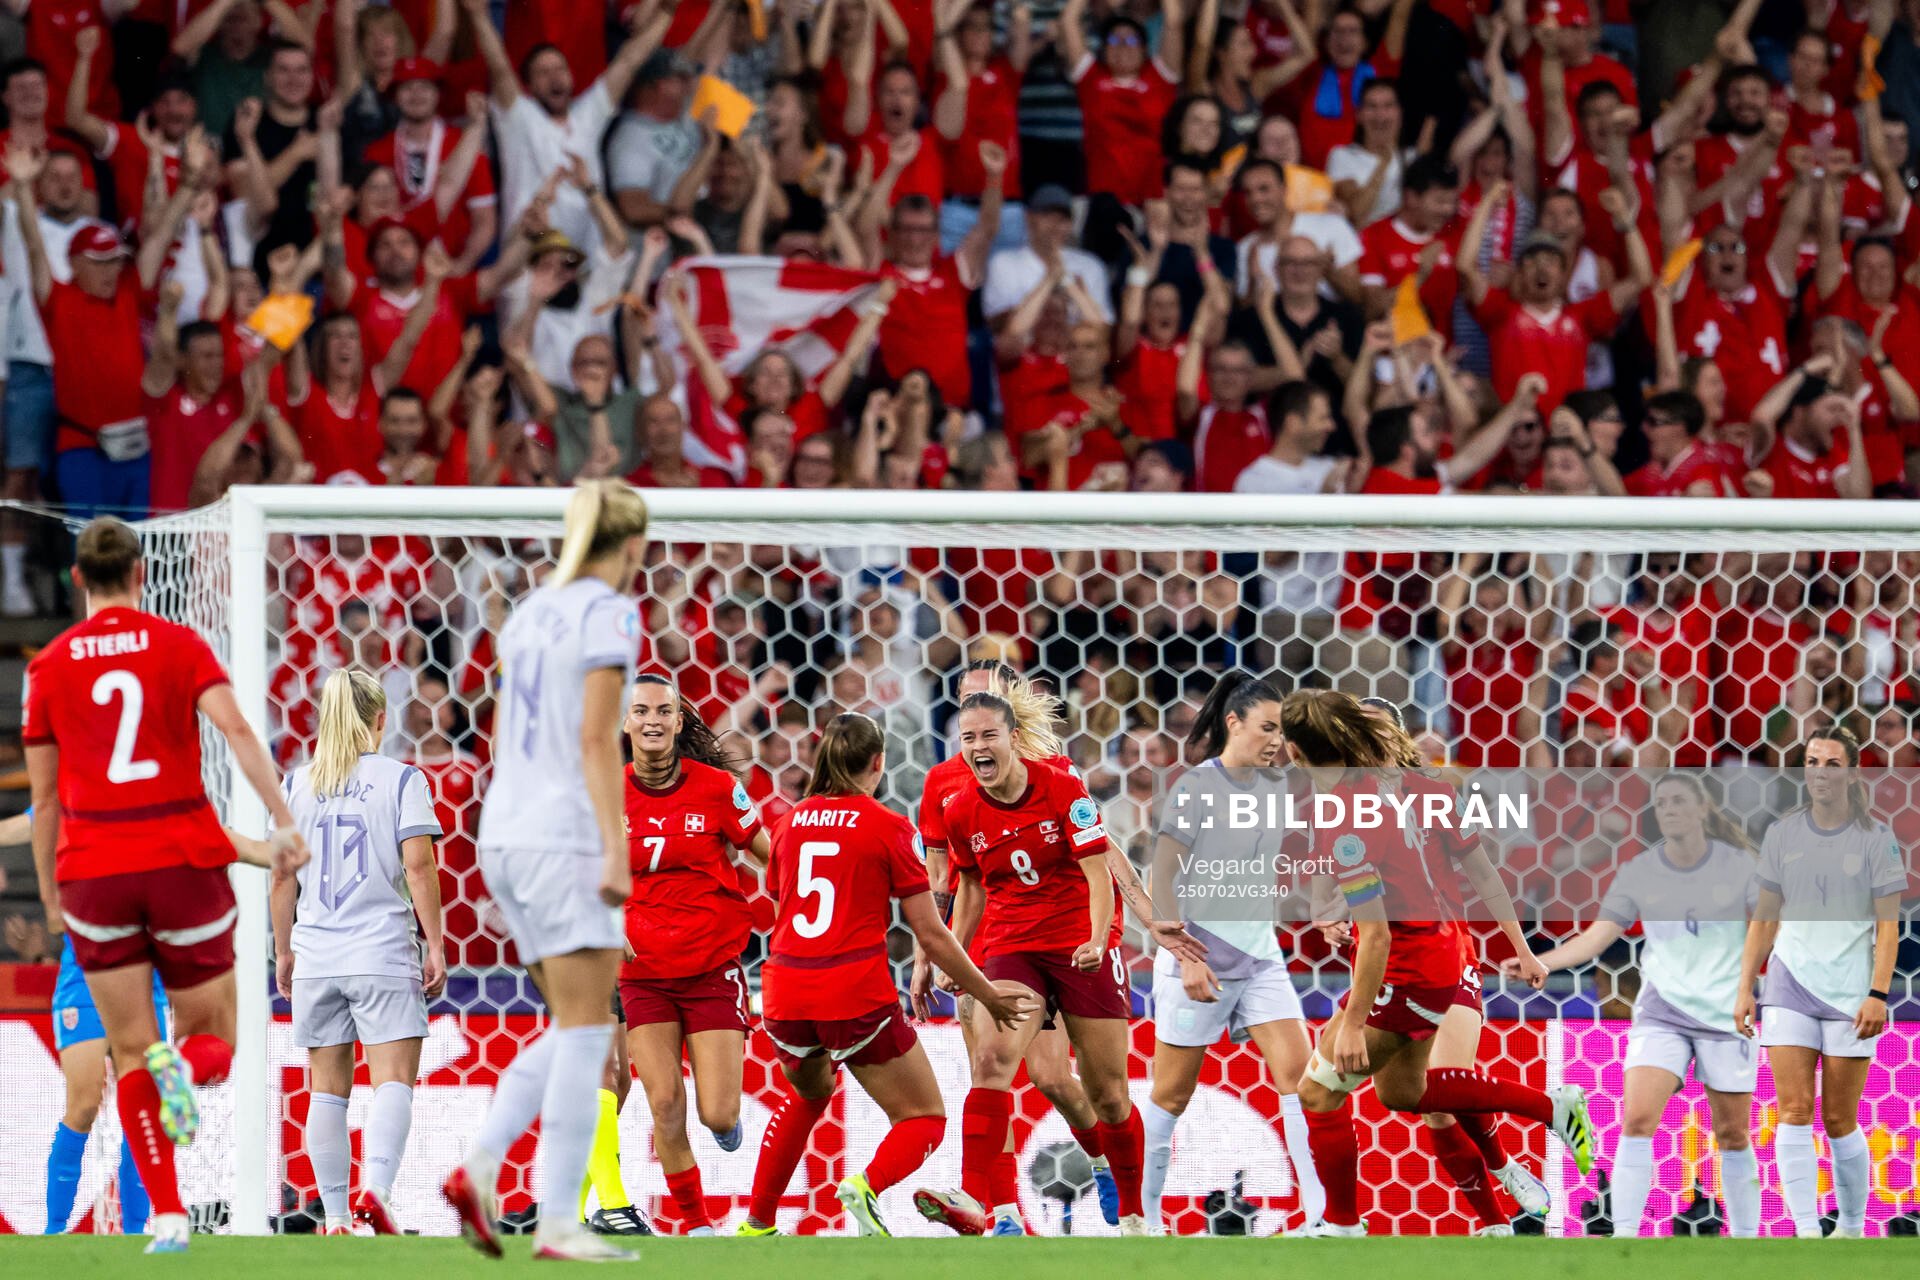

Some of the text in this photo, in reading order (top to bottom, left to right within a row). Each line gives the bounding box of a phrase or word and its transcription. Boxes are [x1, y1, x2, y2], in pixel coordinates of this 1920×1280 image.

[69, 629, 150, 660] STIERLI
[91, 669, 160, 784] 2
[791, 809, 861, 828] MARITZ
[316, 814, 369, 912] 13
[643, 836, 666, 873] 7
[1010, 849, 1040, 886] 8
[792, 841, 840, 939] 5
